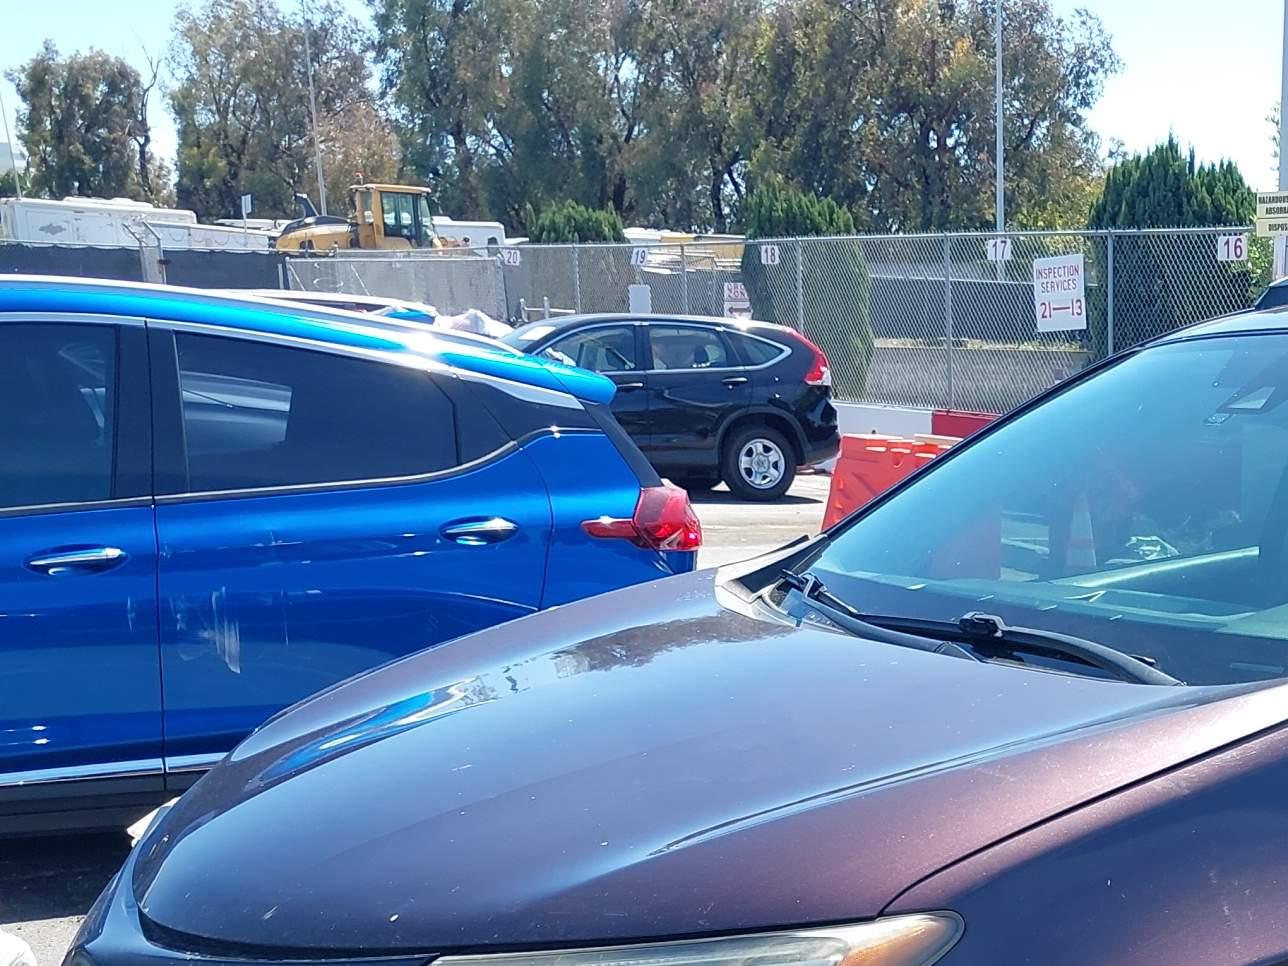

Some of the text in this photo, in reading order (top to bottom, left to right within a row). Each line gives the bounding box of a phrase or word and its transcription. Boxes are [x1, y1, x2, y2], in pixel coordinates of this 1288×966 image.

[764, 247, 776, 264] 18
[992, 240, 1007, 259] 17
[1223, 237, 1243, 259] 16
[506, 250, 518, 264] 20
[634, 249, 646, 264] 19
[1035, 264, 1080, 280] INSPECTION
[1040, 278, 1077, 294] SERVICES
